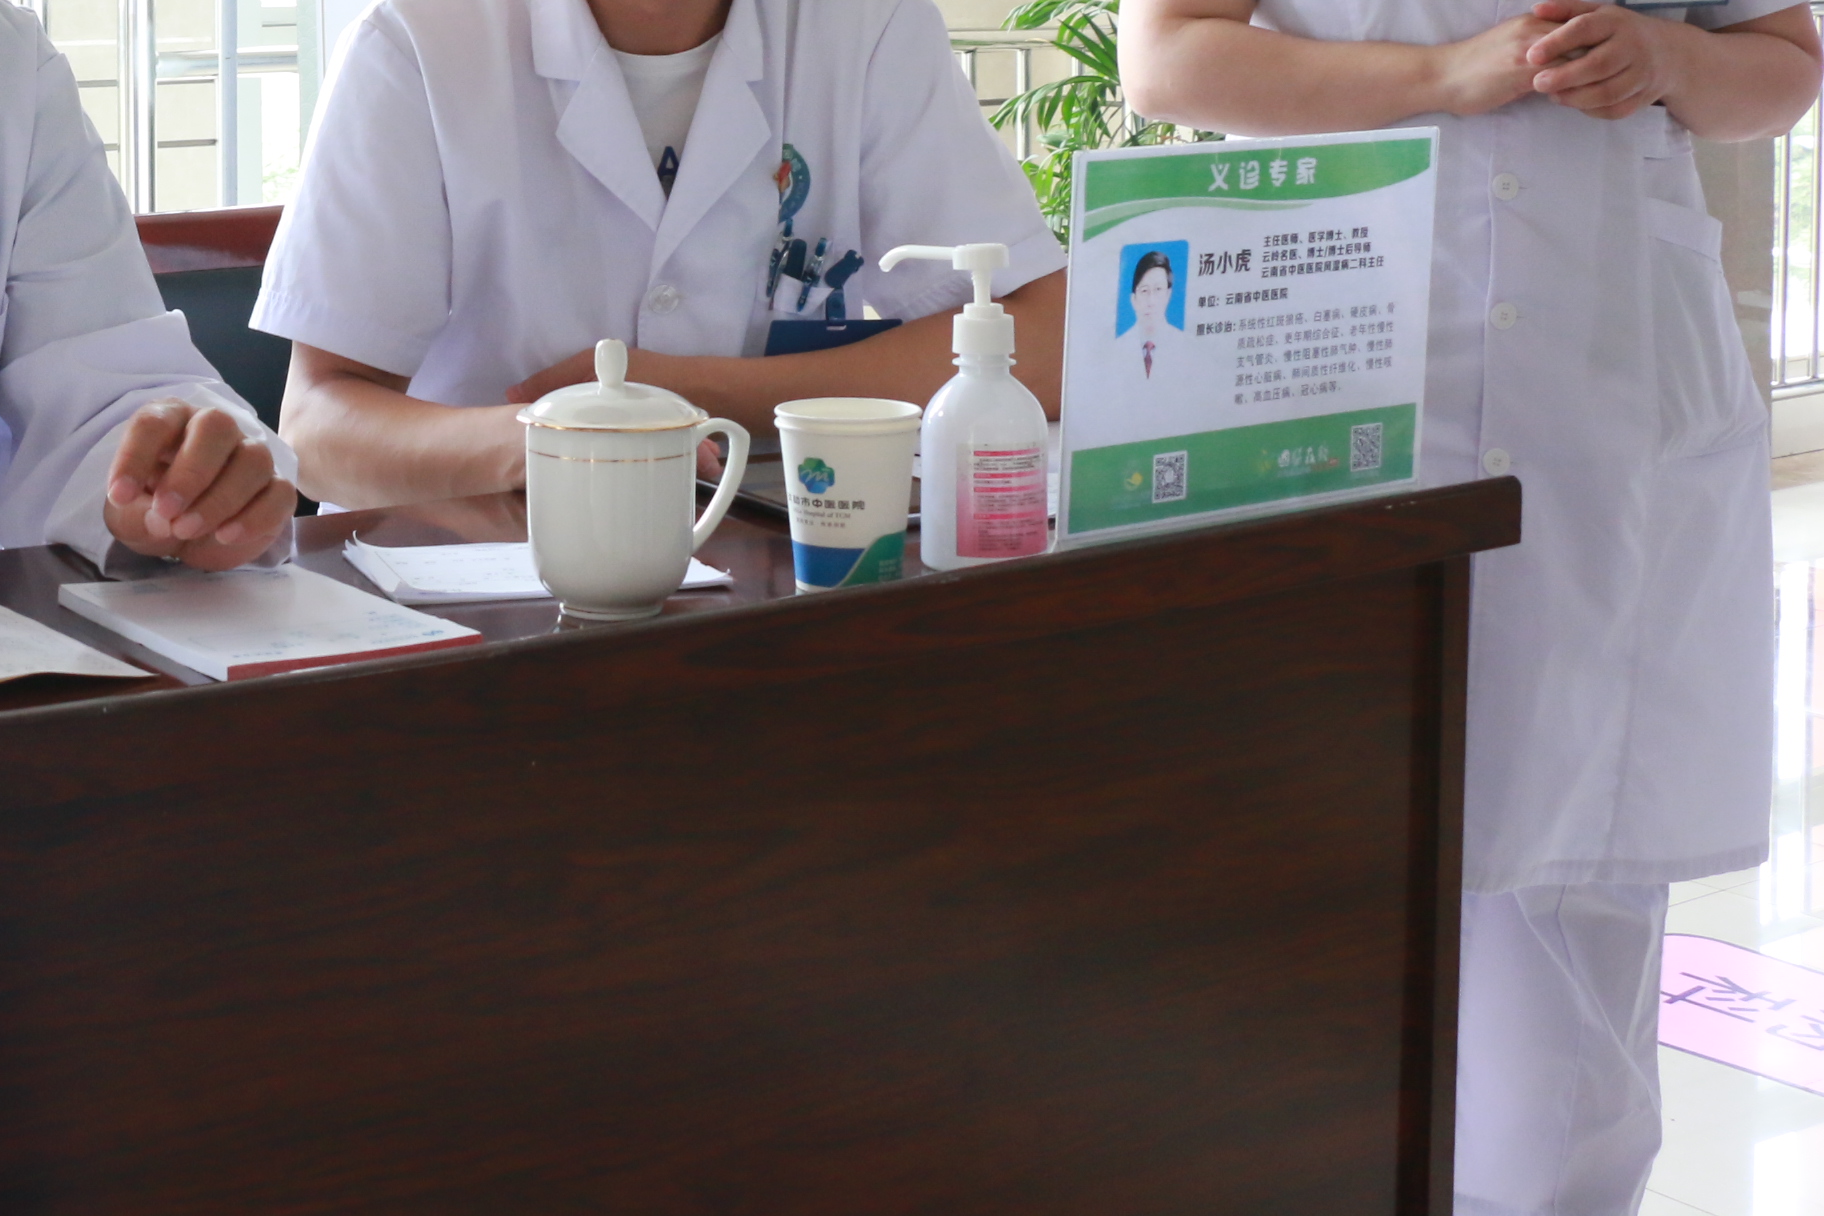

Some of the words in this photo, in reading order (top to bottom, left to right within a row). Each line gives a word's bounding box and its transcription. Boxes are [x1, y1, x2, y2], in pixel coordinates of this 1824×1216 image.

[1207, 156, 1318, 192] 义诊专家
[1262, 226, 1369, 248] 主任医师、医学博士、教授
[1197, 249, 1252, 276] 汤小虎
[1261, 242, 1372, 263] 云岭名医、博士/博士后导师
[1261, 255, 1385, 279] 云南省中医医院风湿病二科主任
[1197, 287, 1289, 309] 单位：云南省中医医院
